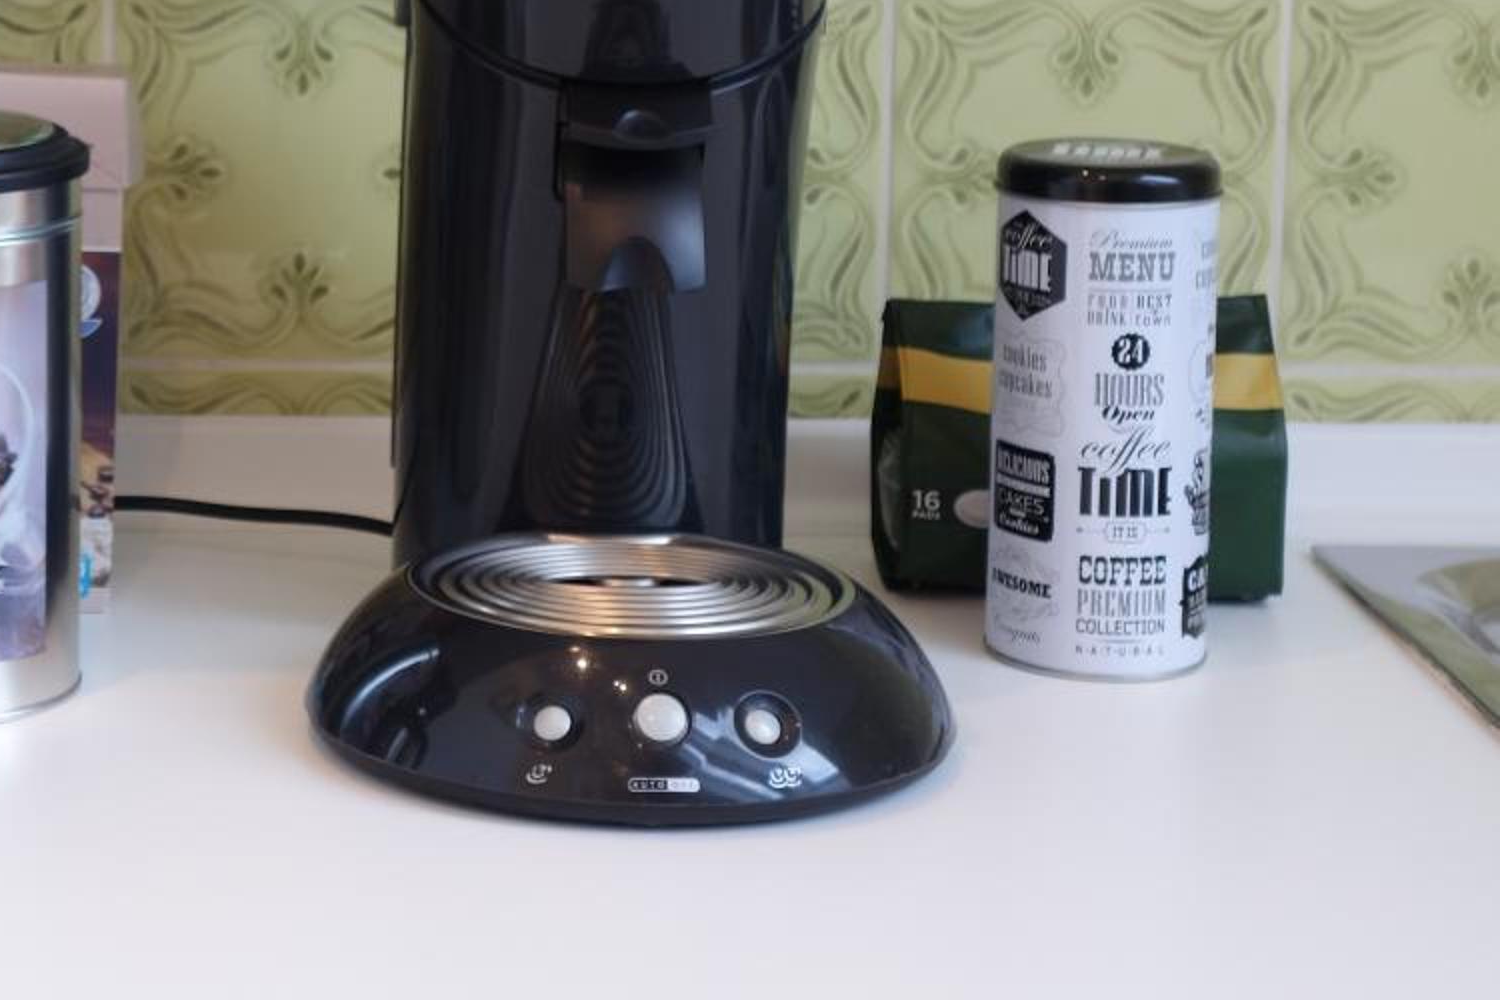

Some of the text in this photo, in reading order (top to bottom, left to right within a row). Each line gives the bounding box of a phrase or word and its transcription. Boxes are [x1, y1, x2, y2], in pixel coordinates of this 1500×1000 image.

[1089, 252, 1176, 281] MENU
[1118, 338, 1143, 364] 24
[1095, 373, 1165, 406] HOURS
[1102, 406, 1155, 425] Open
[1081, 425, 1170, 473] coffee
[912, 490, 941, 510] 16
[1079, 555, 1167, 586] COFFEE
[1077, 588, 1166, 617] PREMIUM
[1076, 618, 1165, 636] COLLECTION
